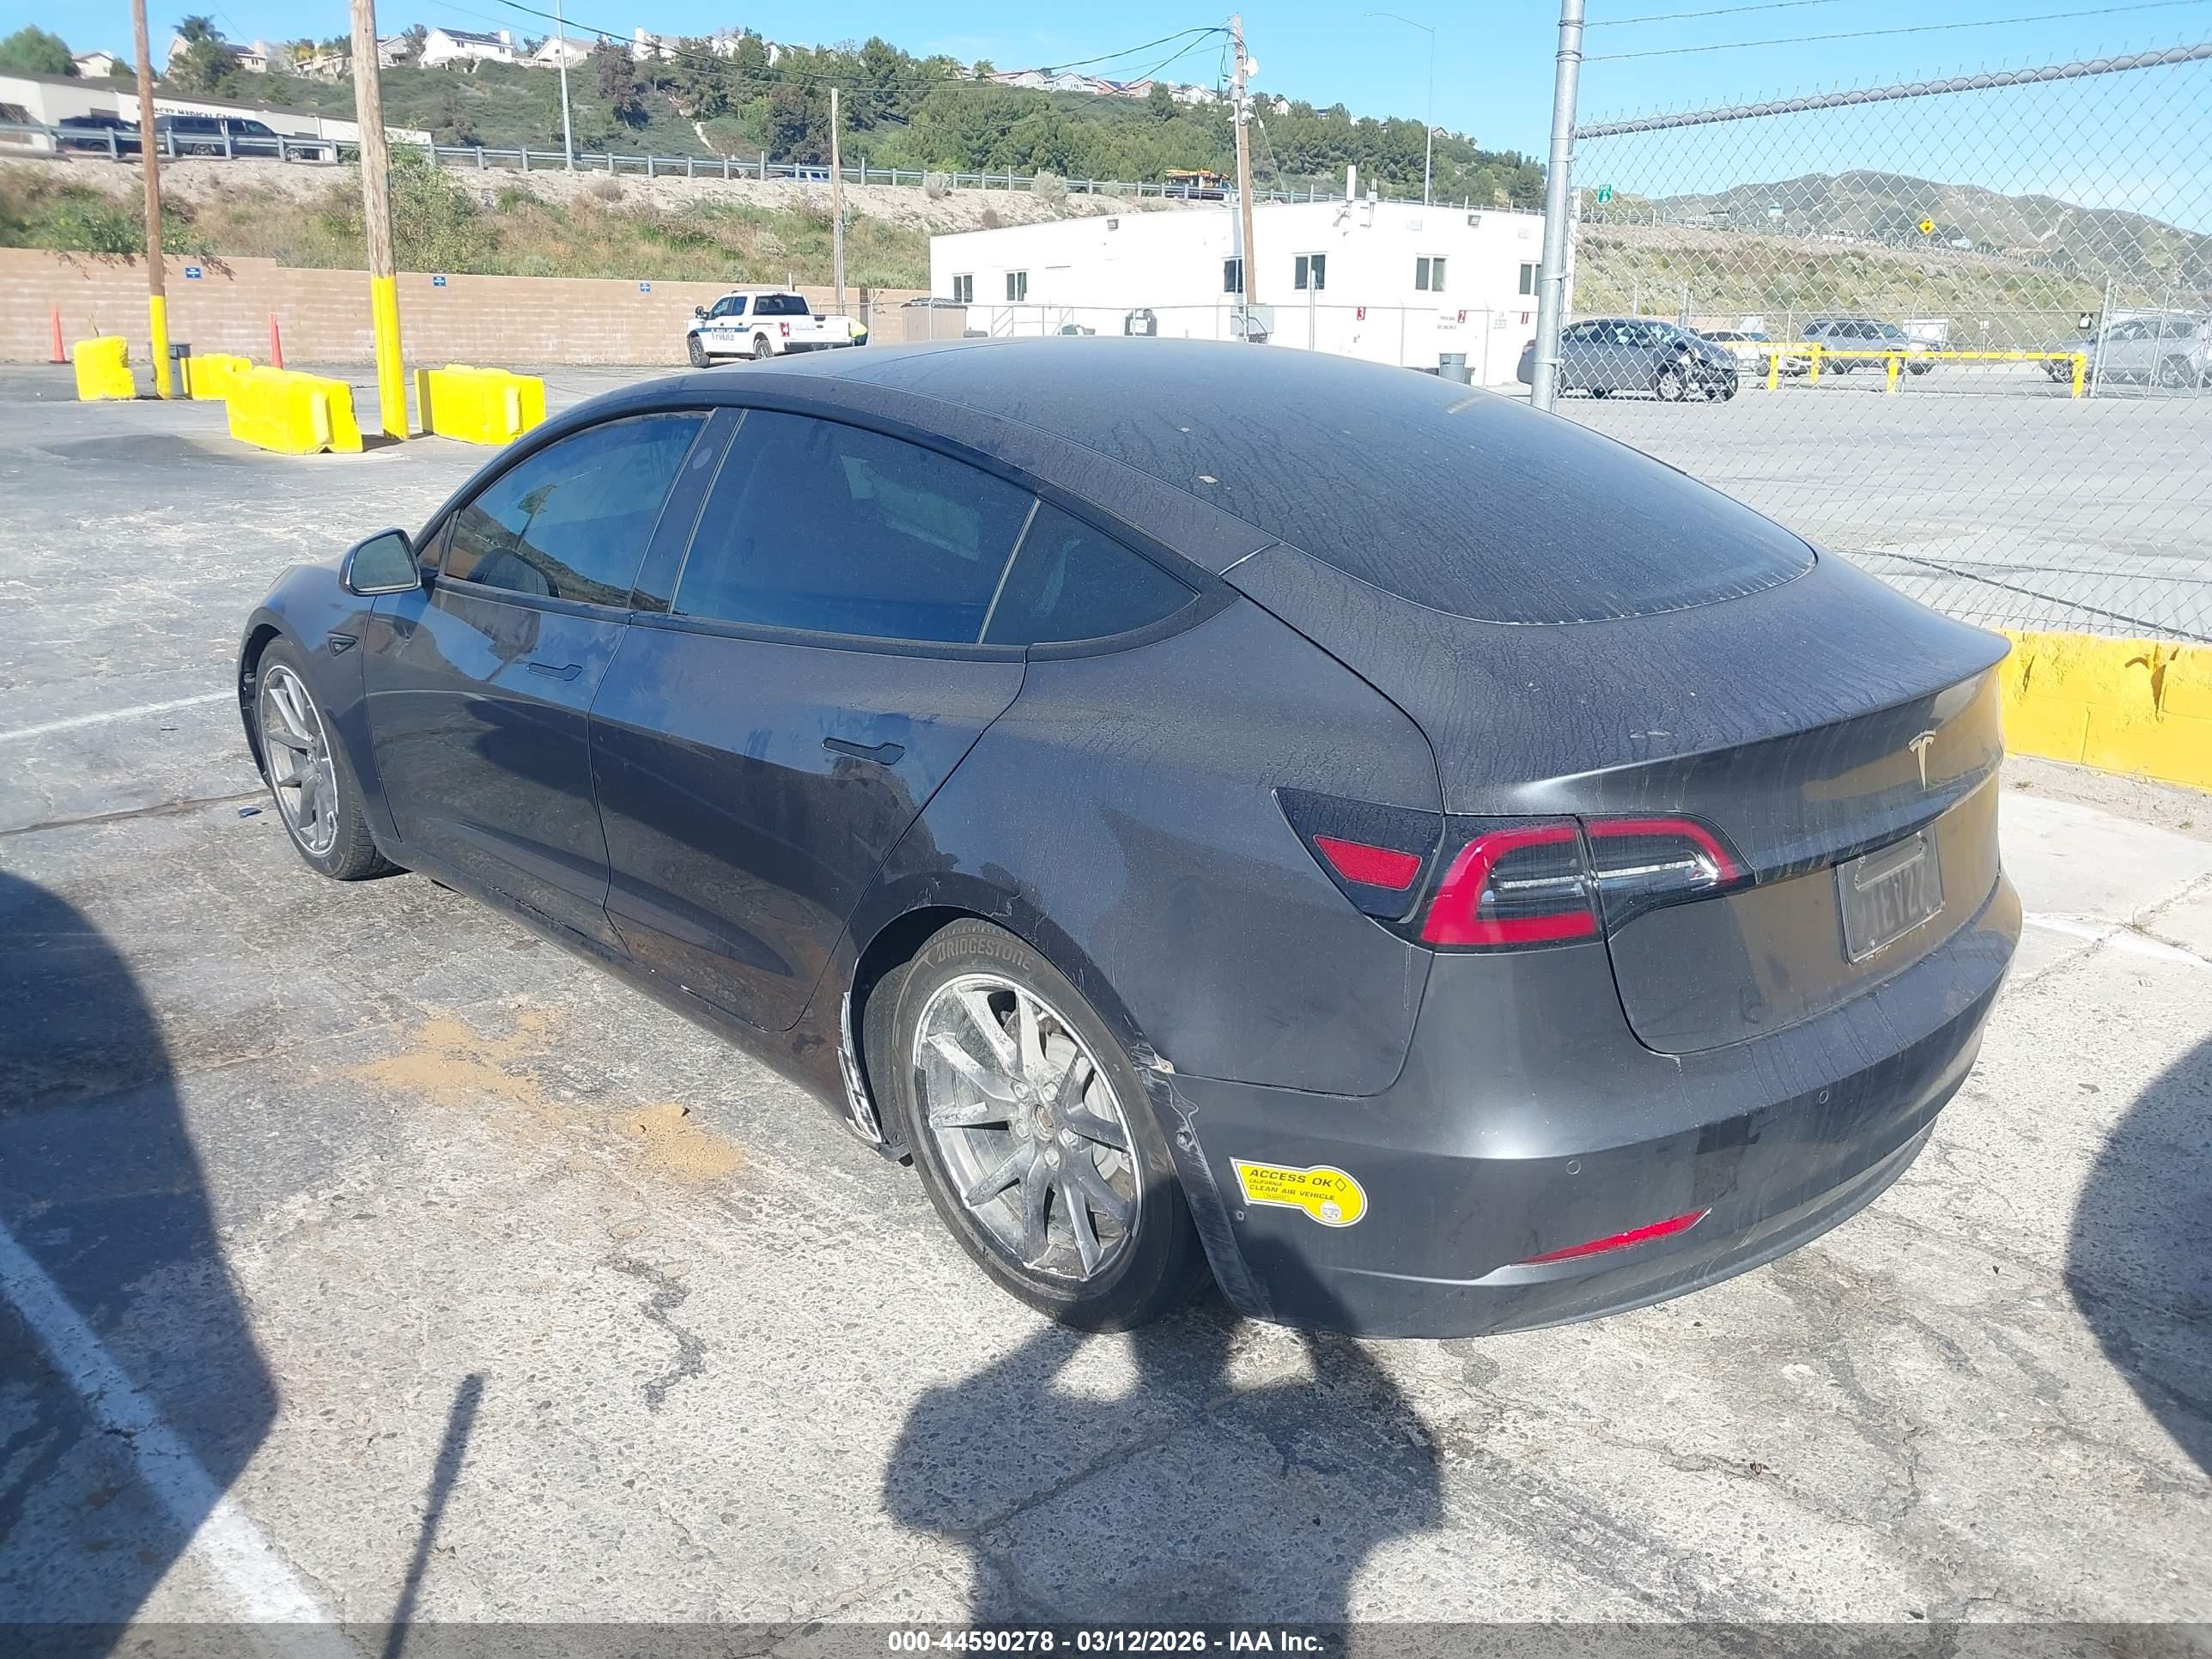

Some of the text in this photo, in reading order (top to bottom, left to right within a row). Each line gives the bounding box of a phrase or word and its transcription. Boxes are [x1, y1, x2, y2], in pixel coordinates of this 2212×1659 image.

[935, 937, 1036, 971] BRIDGESTONE
[1249, 1169, 1334, 1188] ACCESS OK
[1249, 1178, 1283, 1187] CALIFORNIA
[1249, 1184, 1279, 1194] CLEAN
[1280, 1188, 1297, 1196] AIR
[1299, 1191, 1335, 1201] VEHICLE
